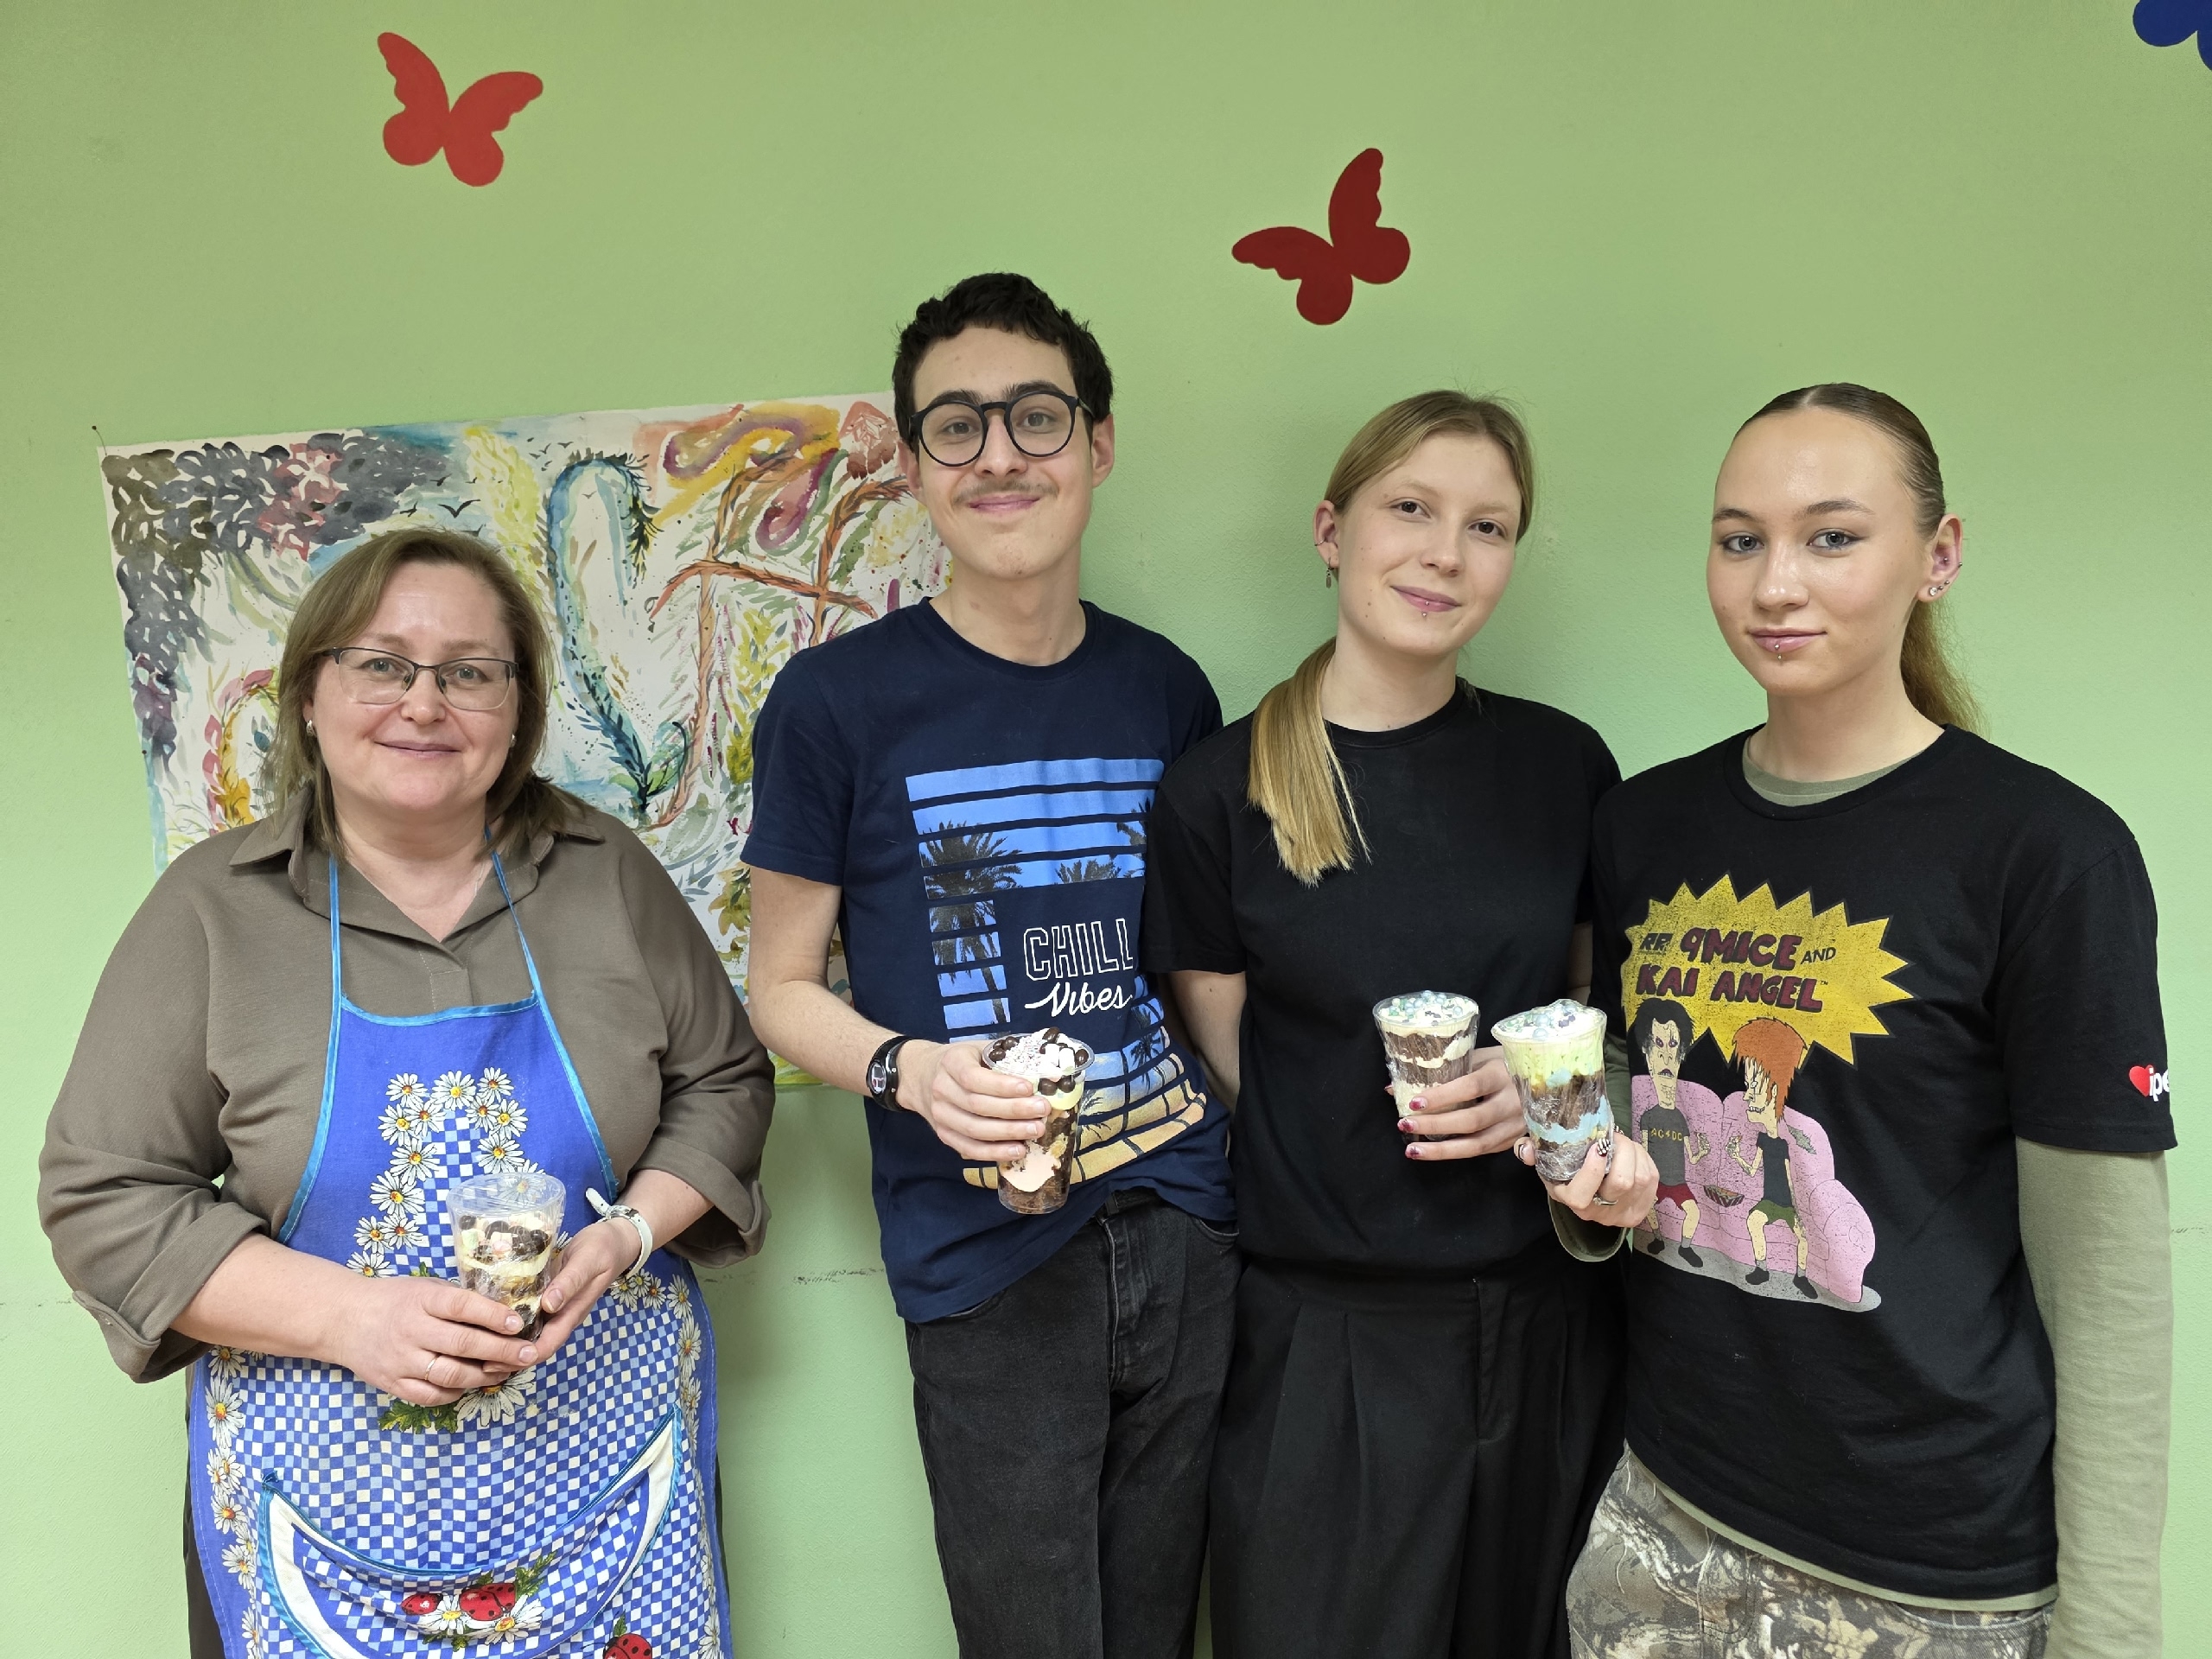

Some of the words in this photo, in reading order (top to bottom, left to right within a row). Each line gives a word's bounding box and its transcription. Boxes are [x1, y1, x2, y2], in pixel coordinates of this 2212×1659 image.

[1023, 918, 1134, 982] CHILL
[1680, 927, 1802, 971] 9MICE
[1800, 946, 1837, 965] AND
[1024, 982, 1133, 1018] Vibes
[1636, 963, 1700, 997] KAI
[1710, 970, 1823, 1014] ANGEL
